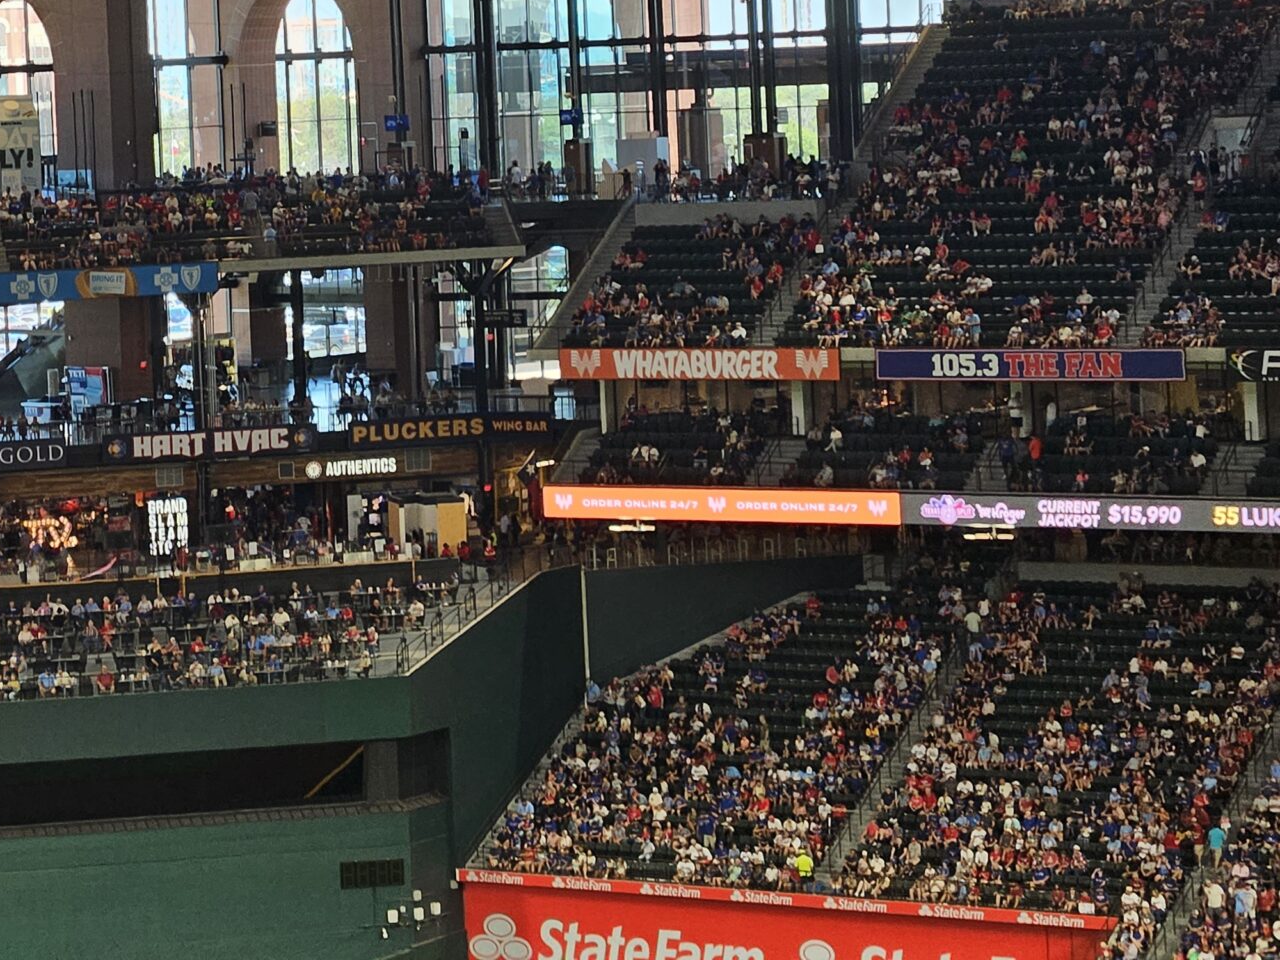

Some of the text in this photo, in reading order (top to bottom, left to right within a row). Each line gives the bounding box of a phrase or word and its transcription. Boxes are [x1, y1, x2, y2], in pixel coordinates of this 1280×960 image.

[613, 350, 778, 378] WHATABURGER
[931, 352, 1123, 378] 105.3 THE FAN
[353, 418, 548, 443] PLUCKERS WING BAR
[133, 428, 289, 458] HART HVAC
[325, 457, 397, 477] AUTHENTICS
[147, 497, 188, 515] GRAND
[582, 498, 699, 510] ORDER ONLINE 24/7
[736, 501, 858, 513] ORDER ONLINE 24/7
[1038, 499, 1100, 515] CURRENT
[149, 512, 188, 528] SLAM
[1038, 514, 1100, 528] JACKPOT
[1108, 504, 1181, 526] $15,990
[1213, 506, 1239, 525] 55
[149, 526, 188, 541] TEAM
